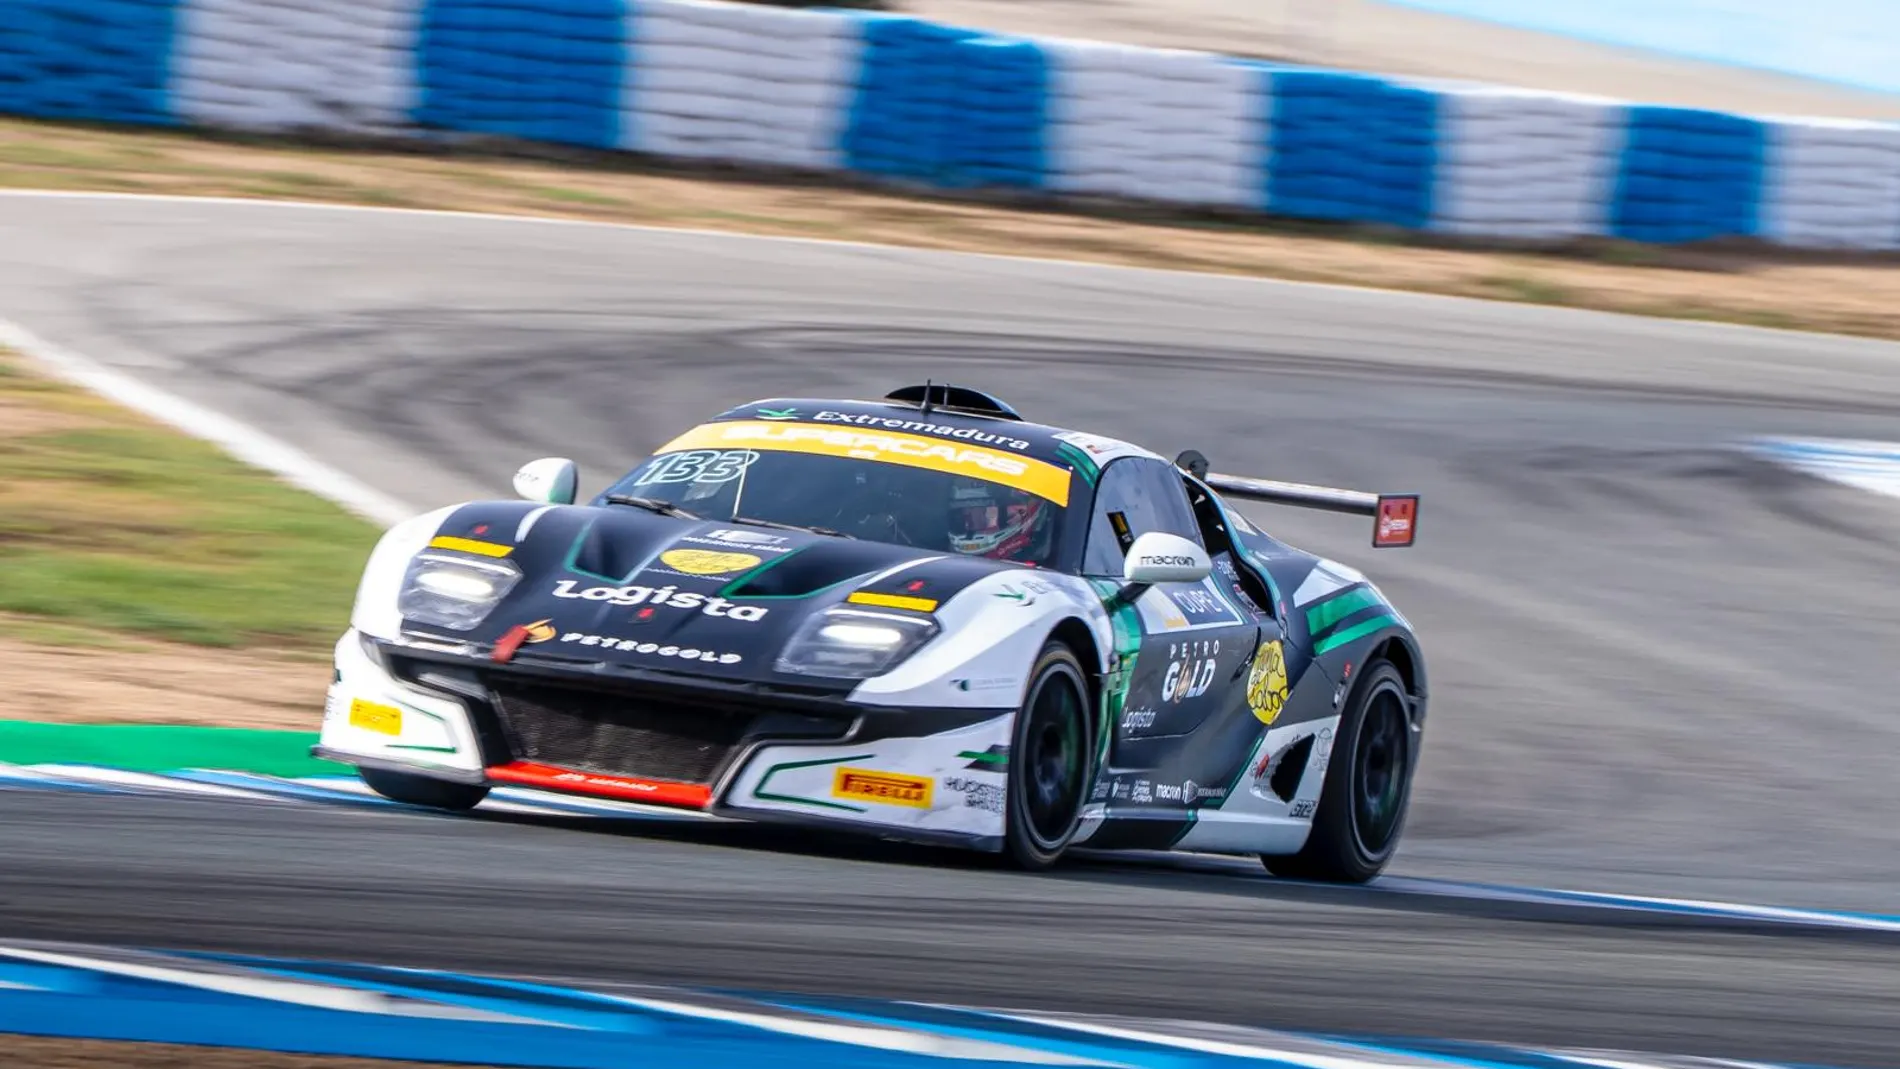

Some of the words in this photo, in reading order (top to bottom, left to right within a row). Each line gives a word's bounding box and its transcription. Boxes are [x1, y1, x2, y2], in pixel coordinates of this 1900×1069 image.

[812, 411, 1030, 451] Extremadura
[721, 424, 1029, 477] SUPERCARS
[633, 450, 761, 487] 133
[1140, 555, 1196, 568] macron
[551, 579, 769, 622] Logista
[560, 631, 743, 665] PETROGOLD
[1169, 639, 1220, 660] PETRO
[842, 773, 927, 802] PIRELLI
[1156, 783, 1181, 800] macron
